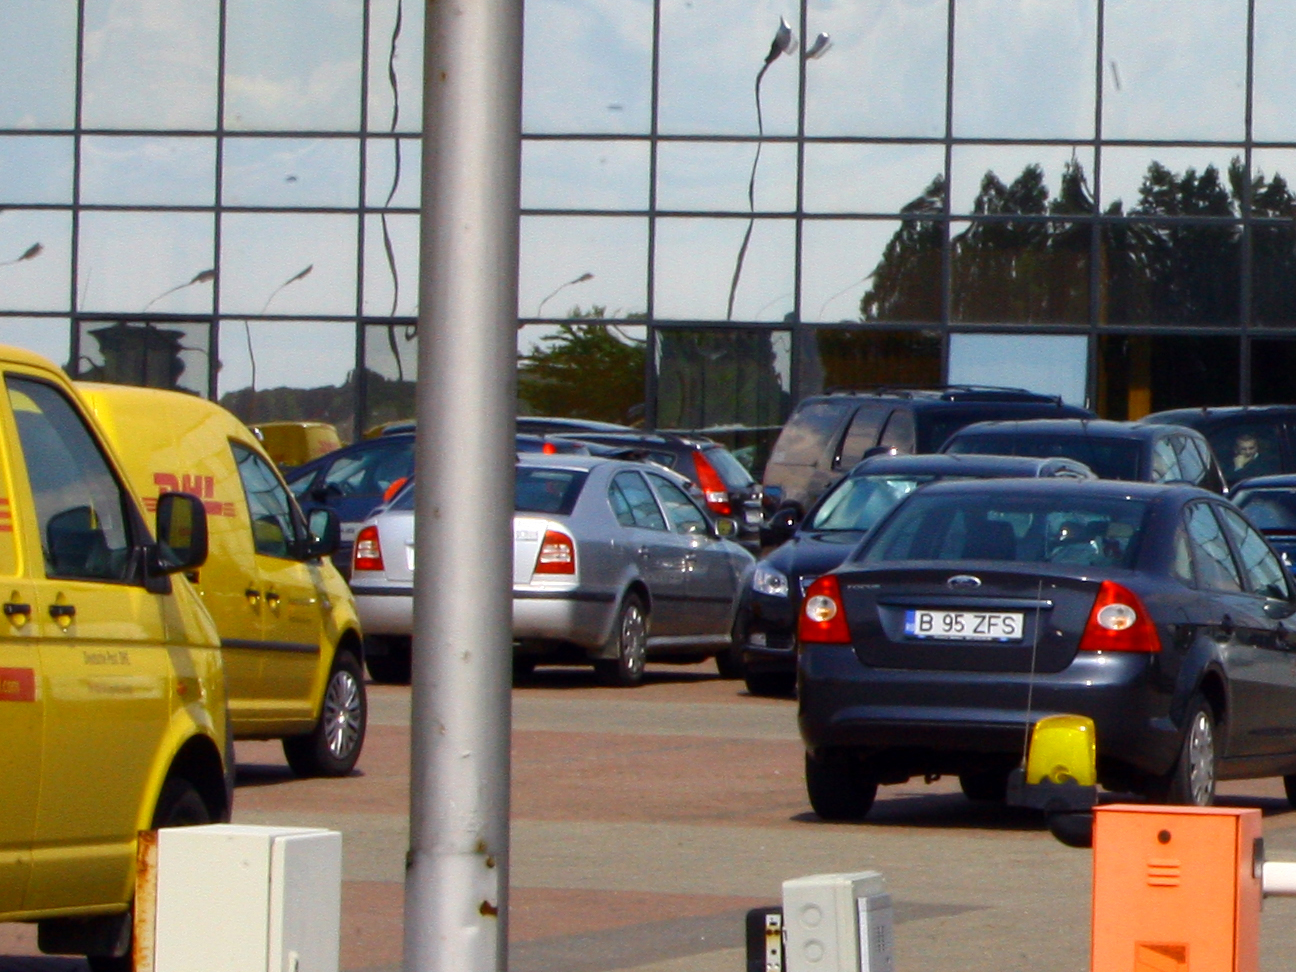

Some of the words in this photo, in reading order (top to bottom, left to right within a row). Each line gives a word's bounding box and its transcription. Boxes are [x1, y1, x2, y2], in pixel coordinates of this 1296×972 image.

[919, 613, 934, 632] B
[942, 614, 965, 633] 95
[972, 615, 1016, 635] ZFS
